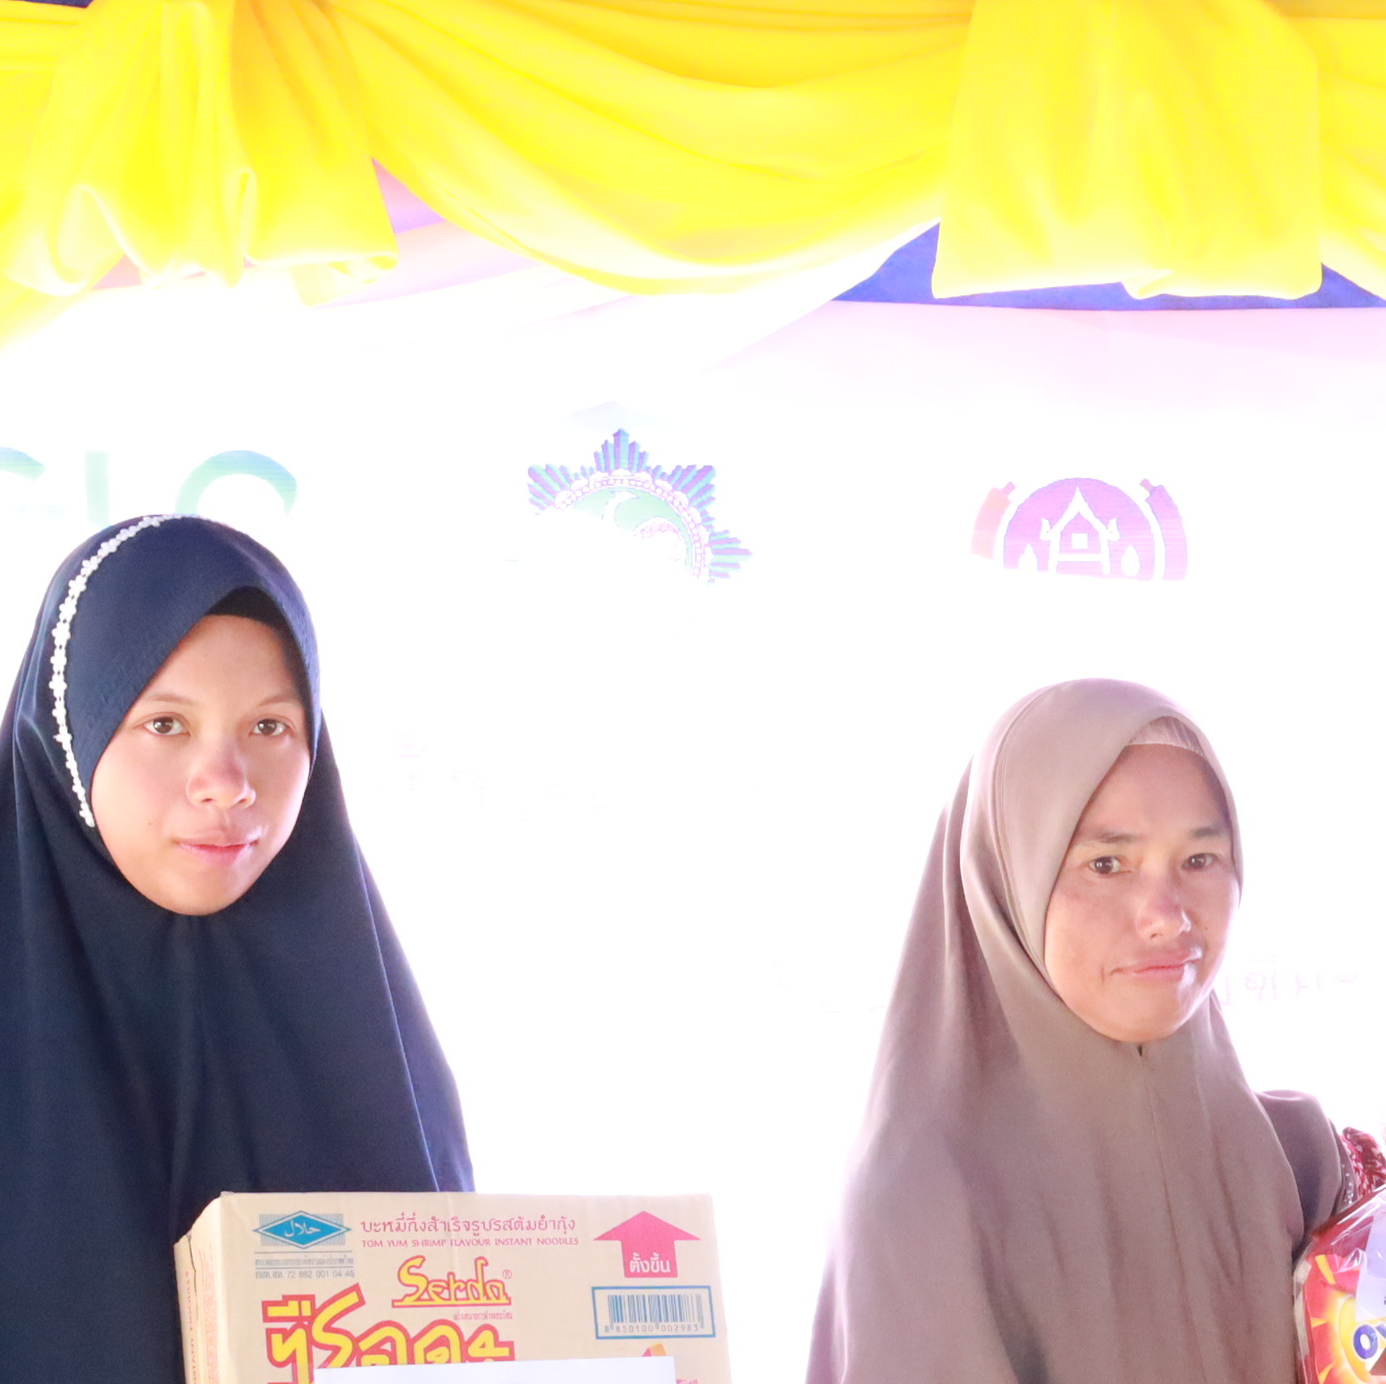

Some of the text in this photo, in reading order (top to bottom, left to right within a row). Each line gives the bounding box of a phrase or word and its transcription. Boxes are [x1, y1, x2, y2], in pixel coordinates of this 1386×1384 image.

[362, 1237, 579, 1248] TOM YUM SHRIMP FLAVOUR INSTANT NOODLES
[629, 1251, 671, 1273] ตั้งขึ้น
[395, 1255, 511, 1306] Serda
